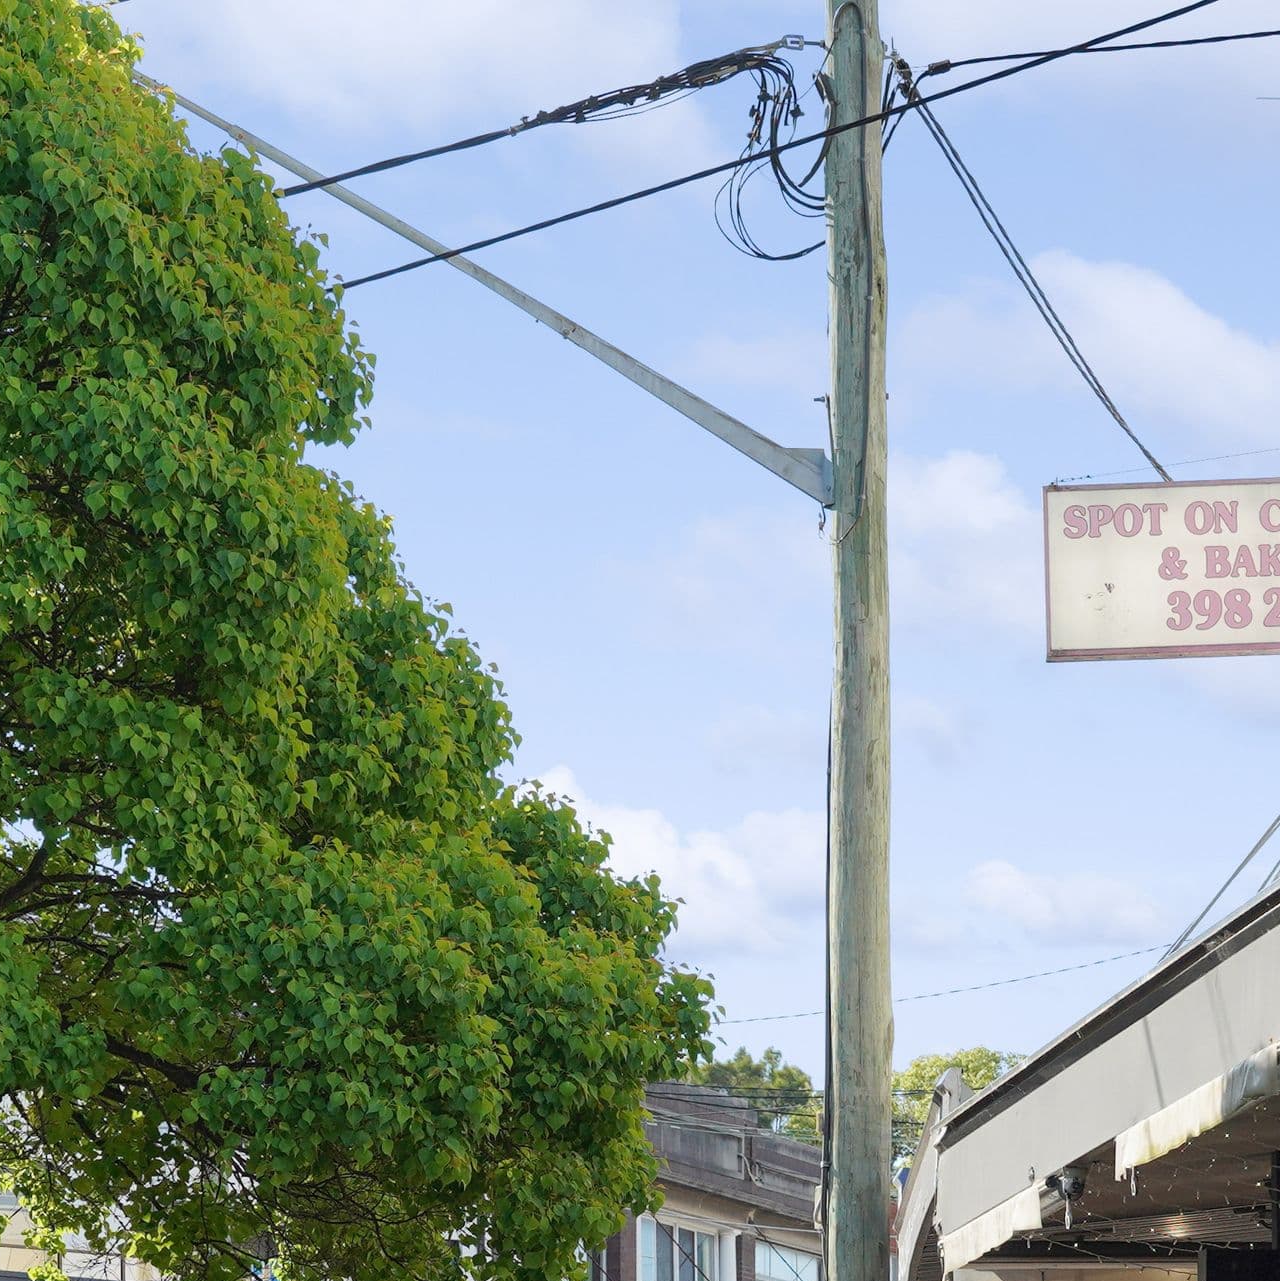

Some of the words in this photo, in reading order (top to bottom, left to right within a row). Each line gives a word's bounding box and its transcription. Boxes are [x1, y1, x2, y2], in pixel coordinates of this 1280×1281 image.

[1063, 503, 1168, 539] SPOT
[1184, 500, 1239, 535] ON
[1158, 546, 1189, 581] &
[1166, 588, 1252, 631] 398
